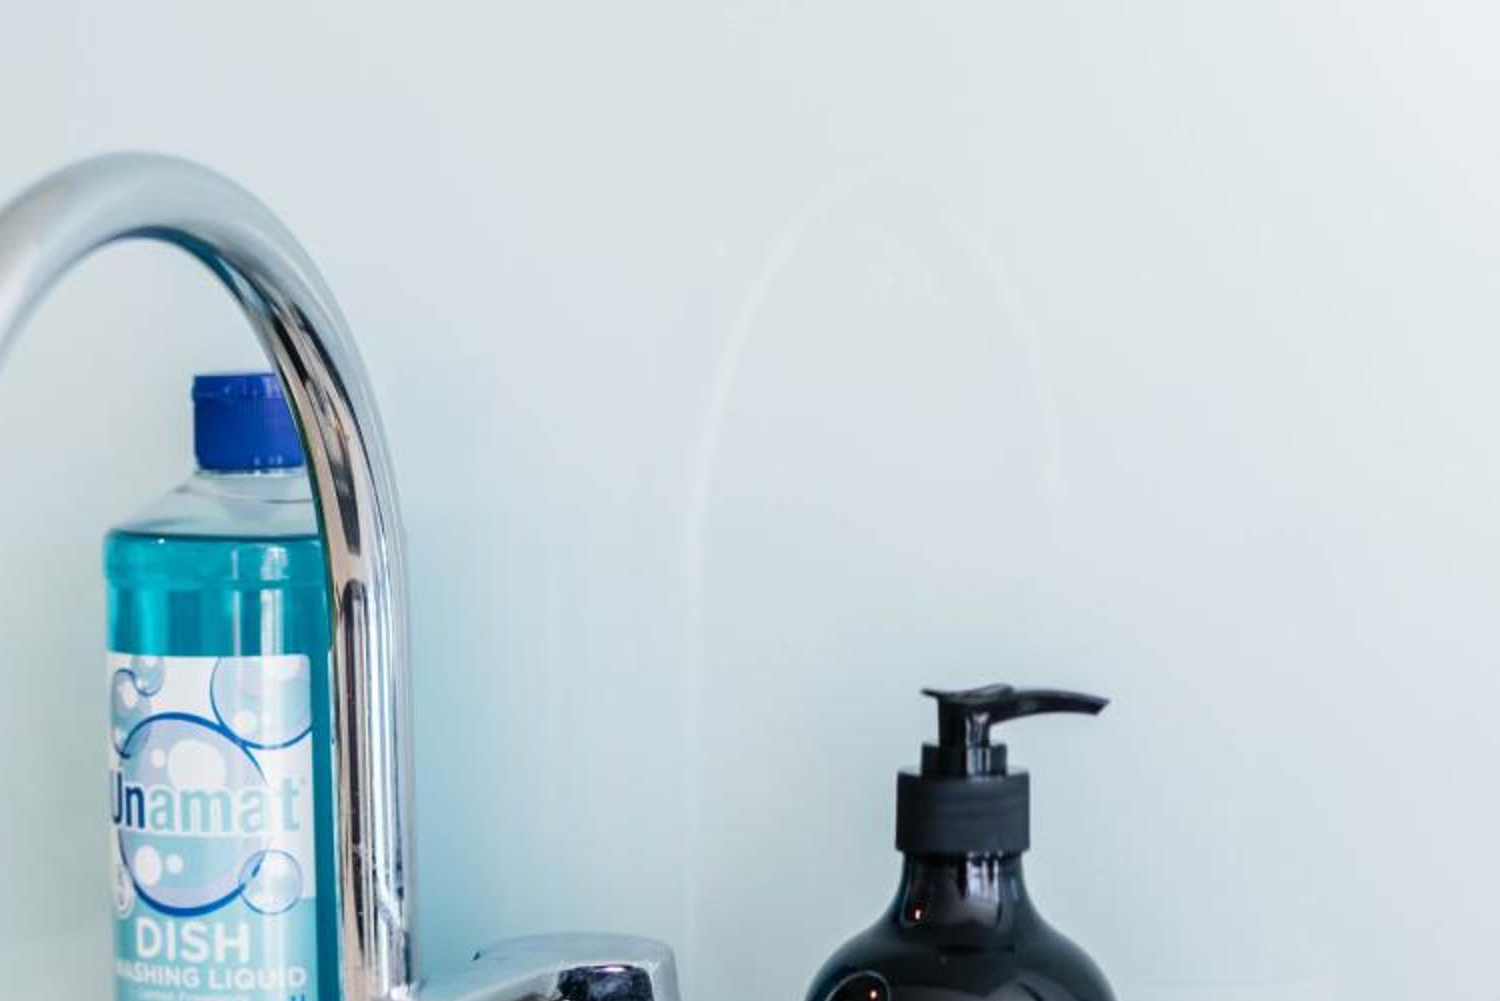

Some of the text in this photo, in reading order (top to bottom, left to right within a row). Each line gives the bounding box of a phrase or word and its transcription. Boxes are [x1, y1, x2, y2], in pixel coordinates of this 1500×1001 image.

[109, 768, 301, 833] Unamat
[135, 916, 251, 963] DISH
[208, 966, 308, 990] LIQUID
